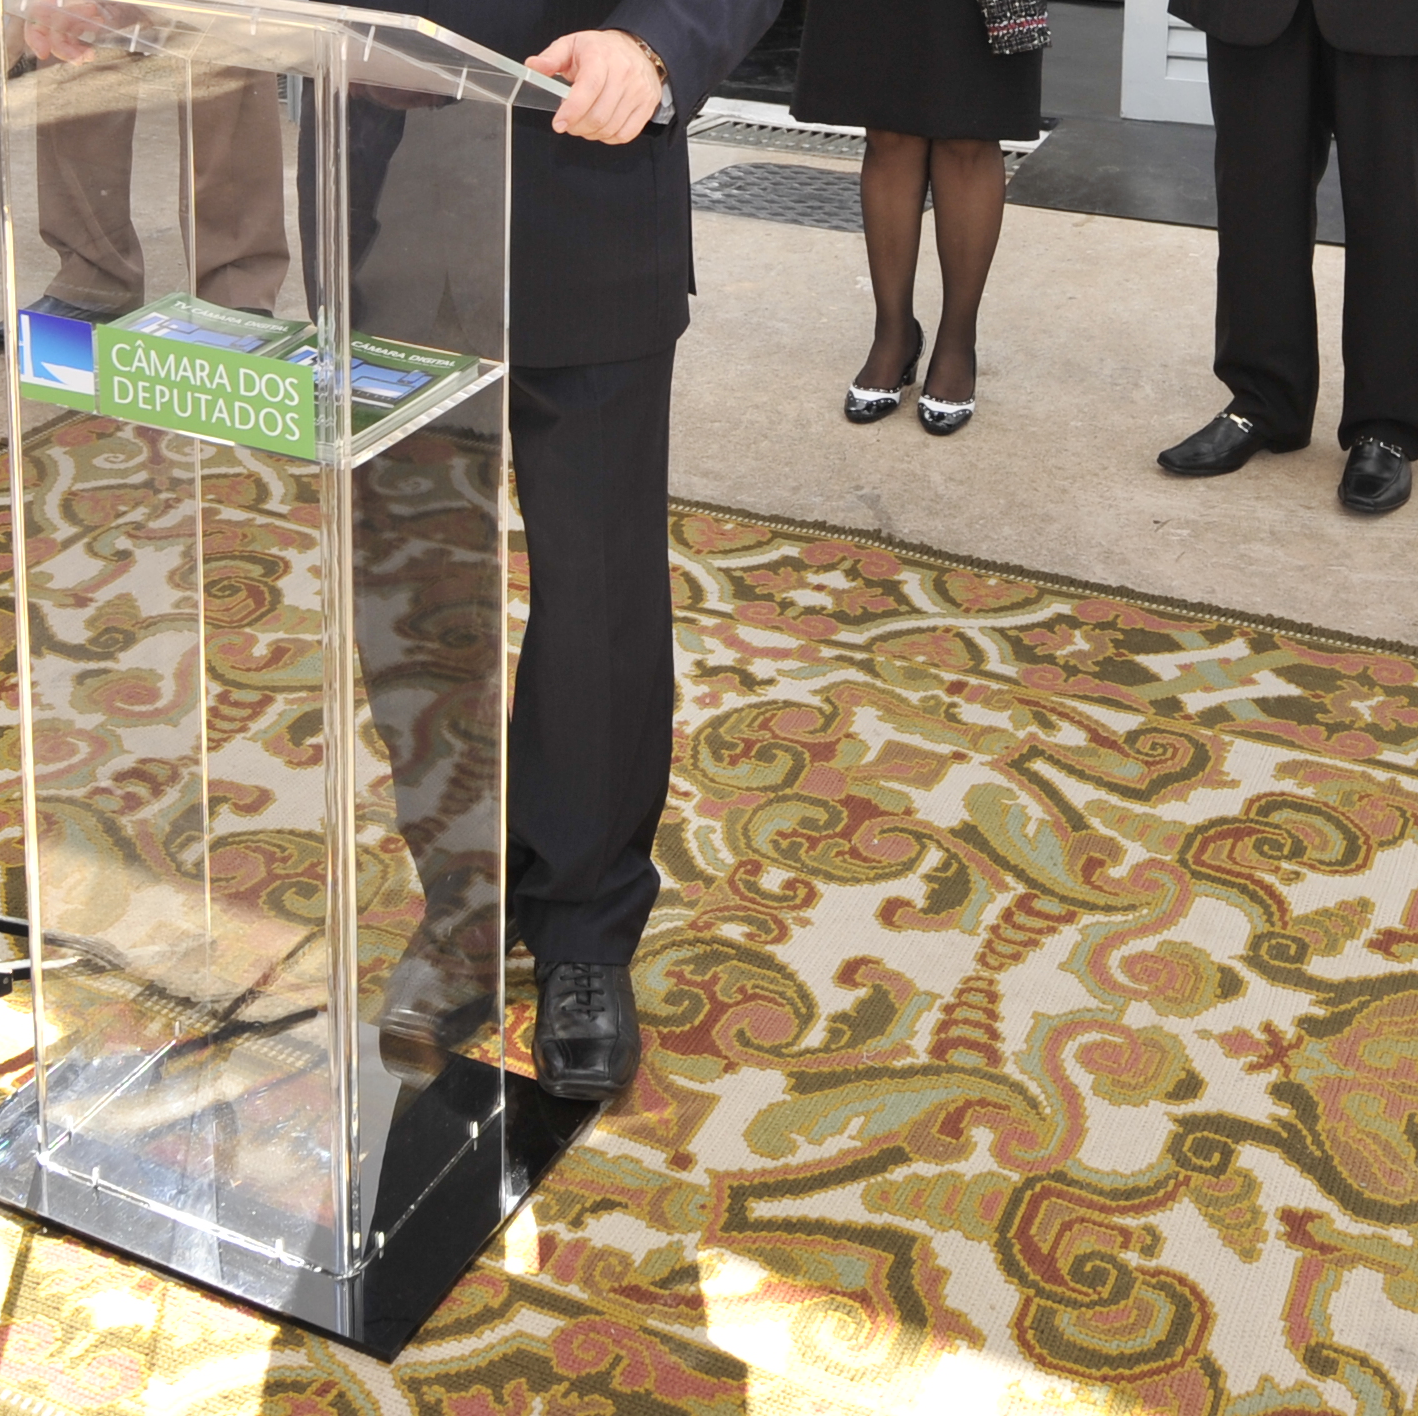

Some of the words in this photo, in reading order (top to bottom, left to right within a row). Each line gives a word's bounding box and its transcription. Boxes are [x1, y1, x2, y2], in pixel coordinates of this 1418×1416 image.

[174, 300, 192, 310] TV
[244, 319, 290, 333] DIGITAL
[110, 339, 233, 395] CÂMARA
[238, 366, 300, 407] DOS
[408, 353, 456, 367] DIGITAL
[112, 376, 302, 442] DEPUTADOS
